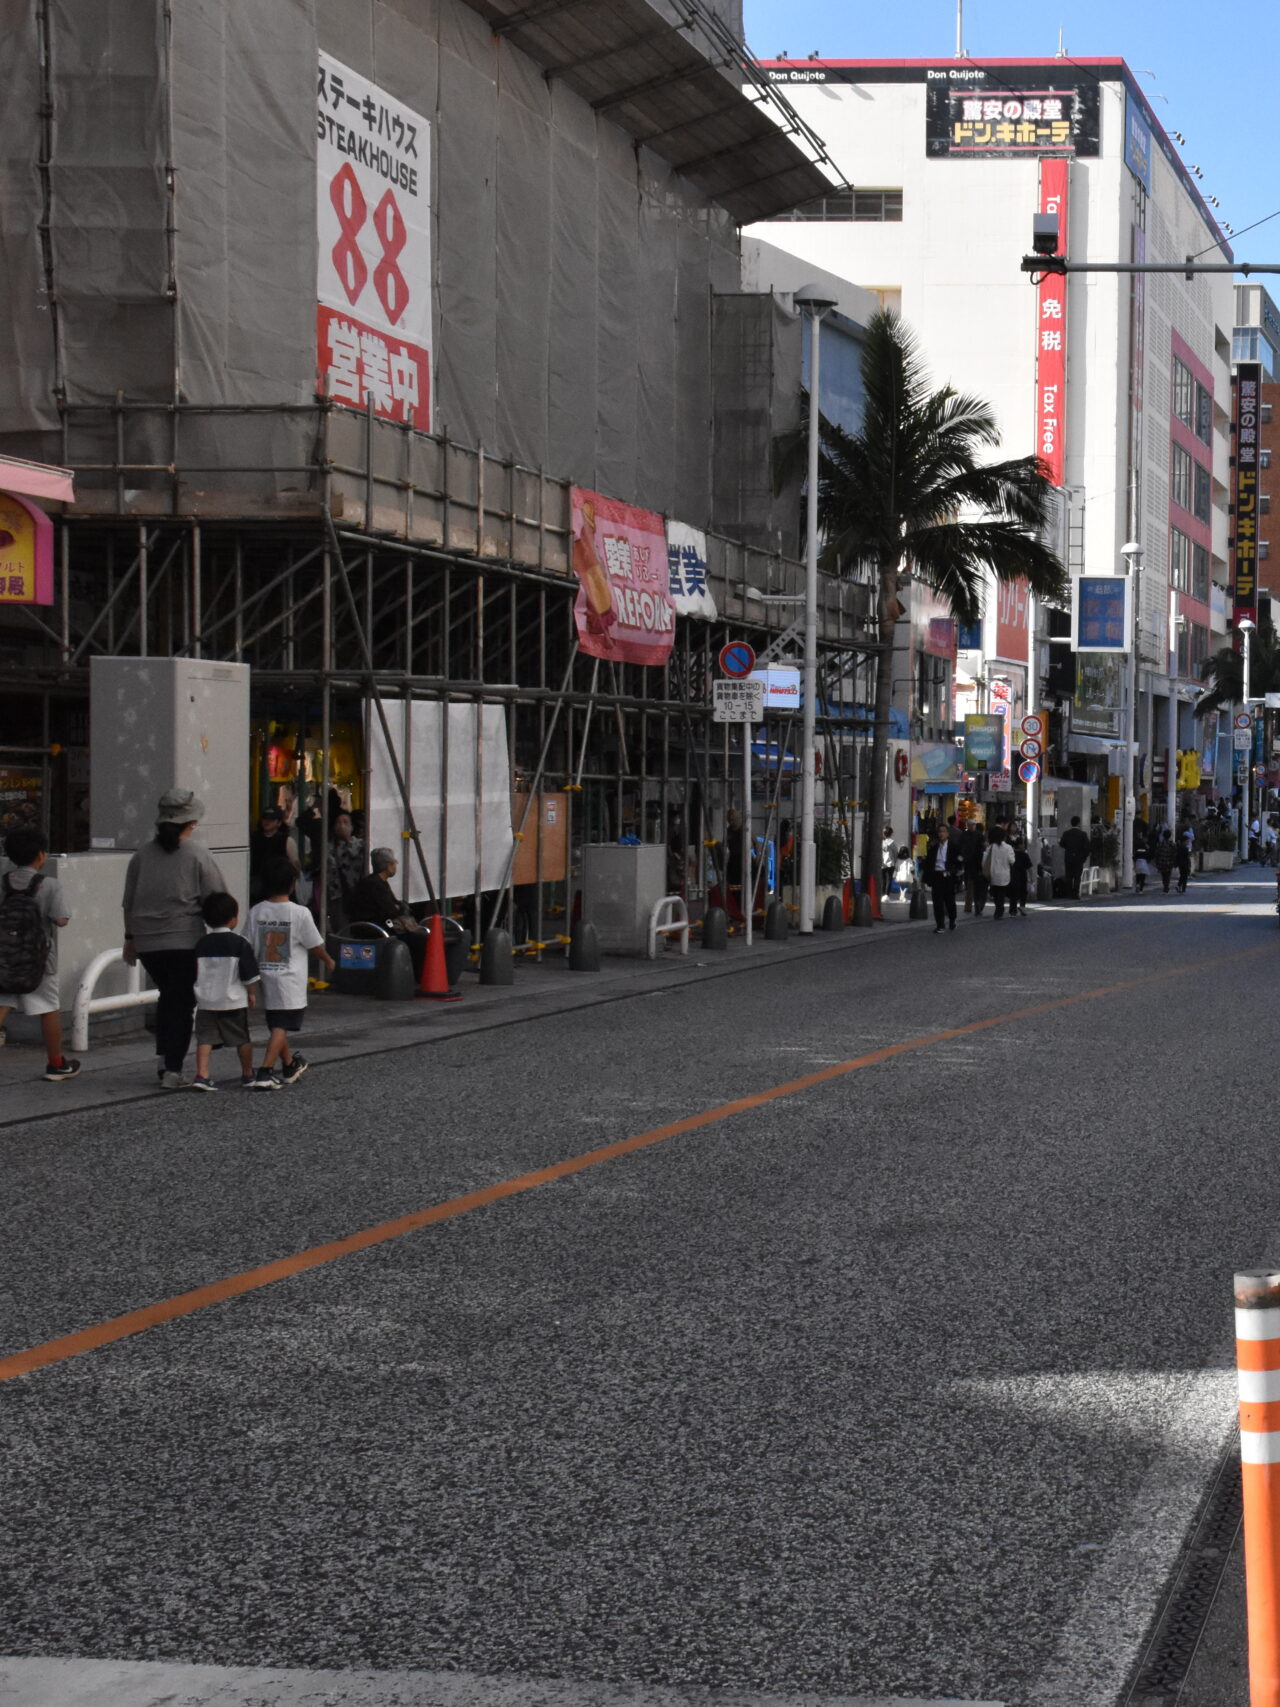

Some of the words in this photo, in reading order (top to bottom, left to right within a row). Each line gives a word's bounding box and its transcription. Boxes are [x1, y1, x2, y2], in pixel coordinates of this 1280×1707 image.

[768, 71, 788, 80] Don
[790, 71, 826, 82] Quijote
[927, 70, 947, 79] Don
[949, 70, 985, 80] Quijote
[318, 66, 418, 160] ステーキハウス
[962, 99, 1063, 121] 驚安の殿堂
[318, 110, 418, 197] STEAKHOUSE
[329, 161, 410, 327] 88
[1041, 298, 1061, 351] 免税
[327, 317, 420, 421] 営業中
[1043, 384, 1057, 413] Tax
[1043, 416, 1057, 453] Free
[1239, 380, 1256, 463] 驚安の殿堂
[719, 711, 757, 720] ここまで
[1026, 721, 1039, 731] 30
